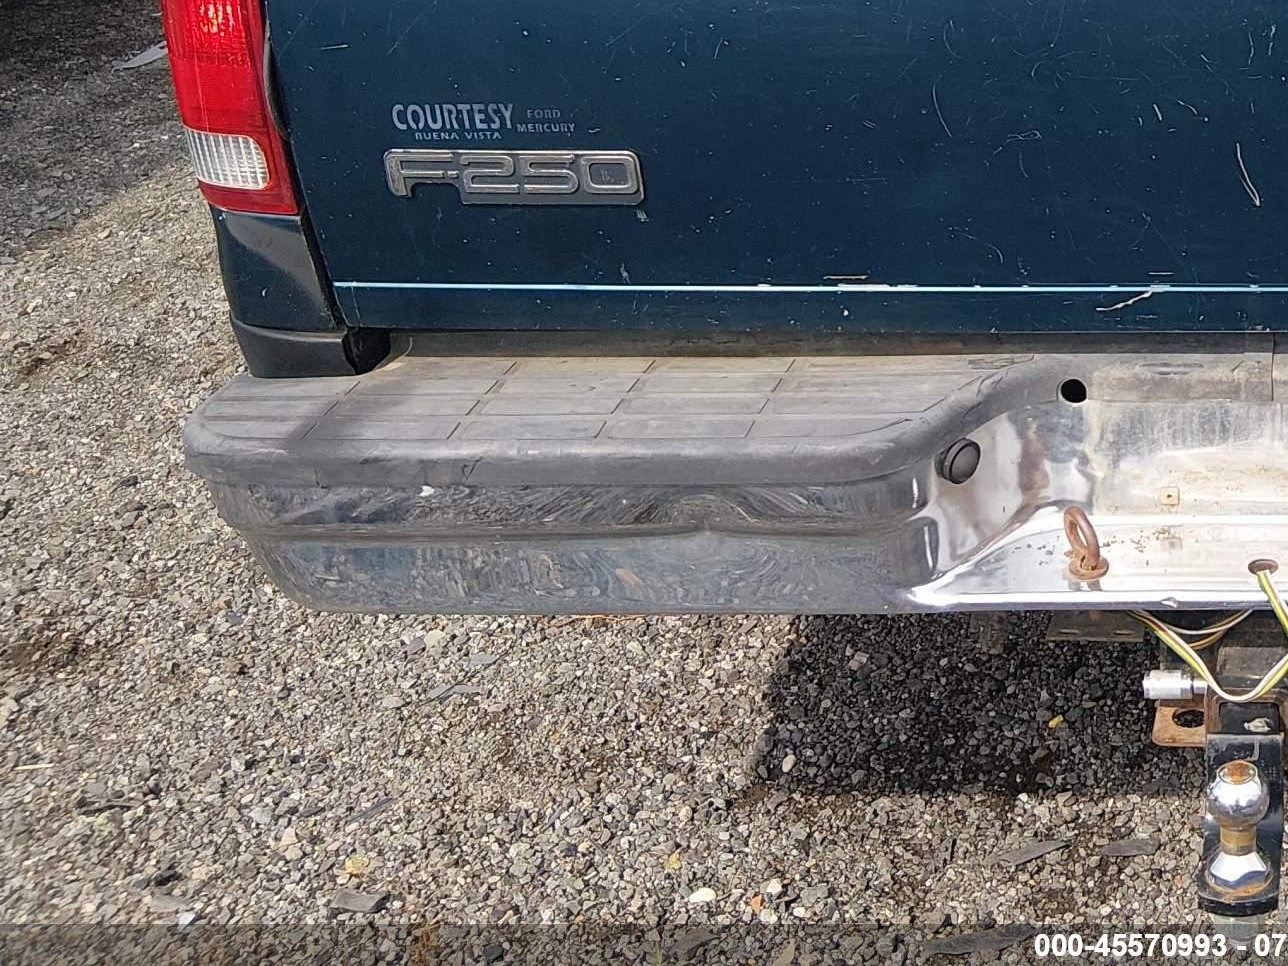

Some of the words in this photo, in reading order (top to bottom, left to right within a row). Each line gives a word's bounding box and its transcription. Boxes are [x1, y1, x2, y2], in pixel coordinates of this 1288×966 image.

[392, 103, 513, 130] COURTESY
[527, 109, 561, 119] FORD
[517, 123, 575, 133] MERCURY
[415, 131, 459, 140] BUENA
[464, 131, 502, 140] VISTA
[385, 151, 640, 198] F-250
